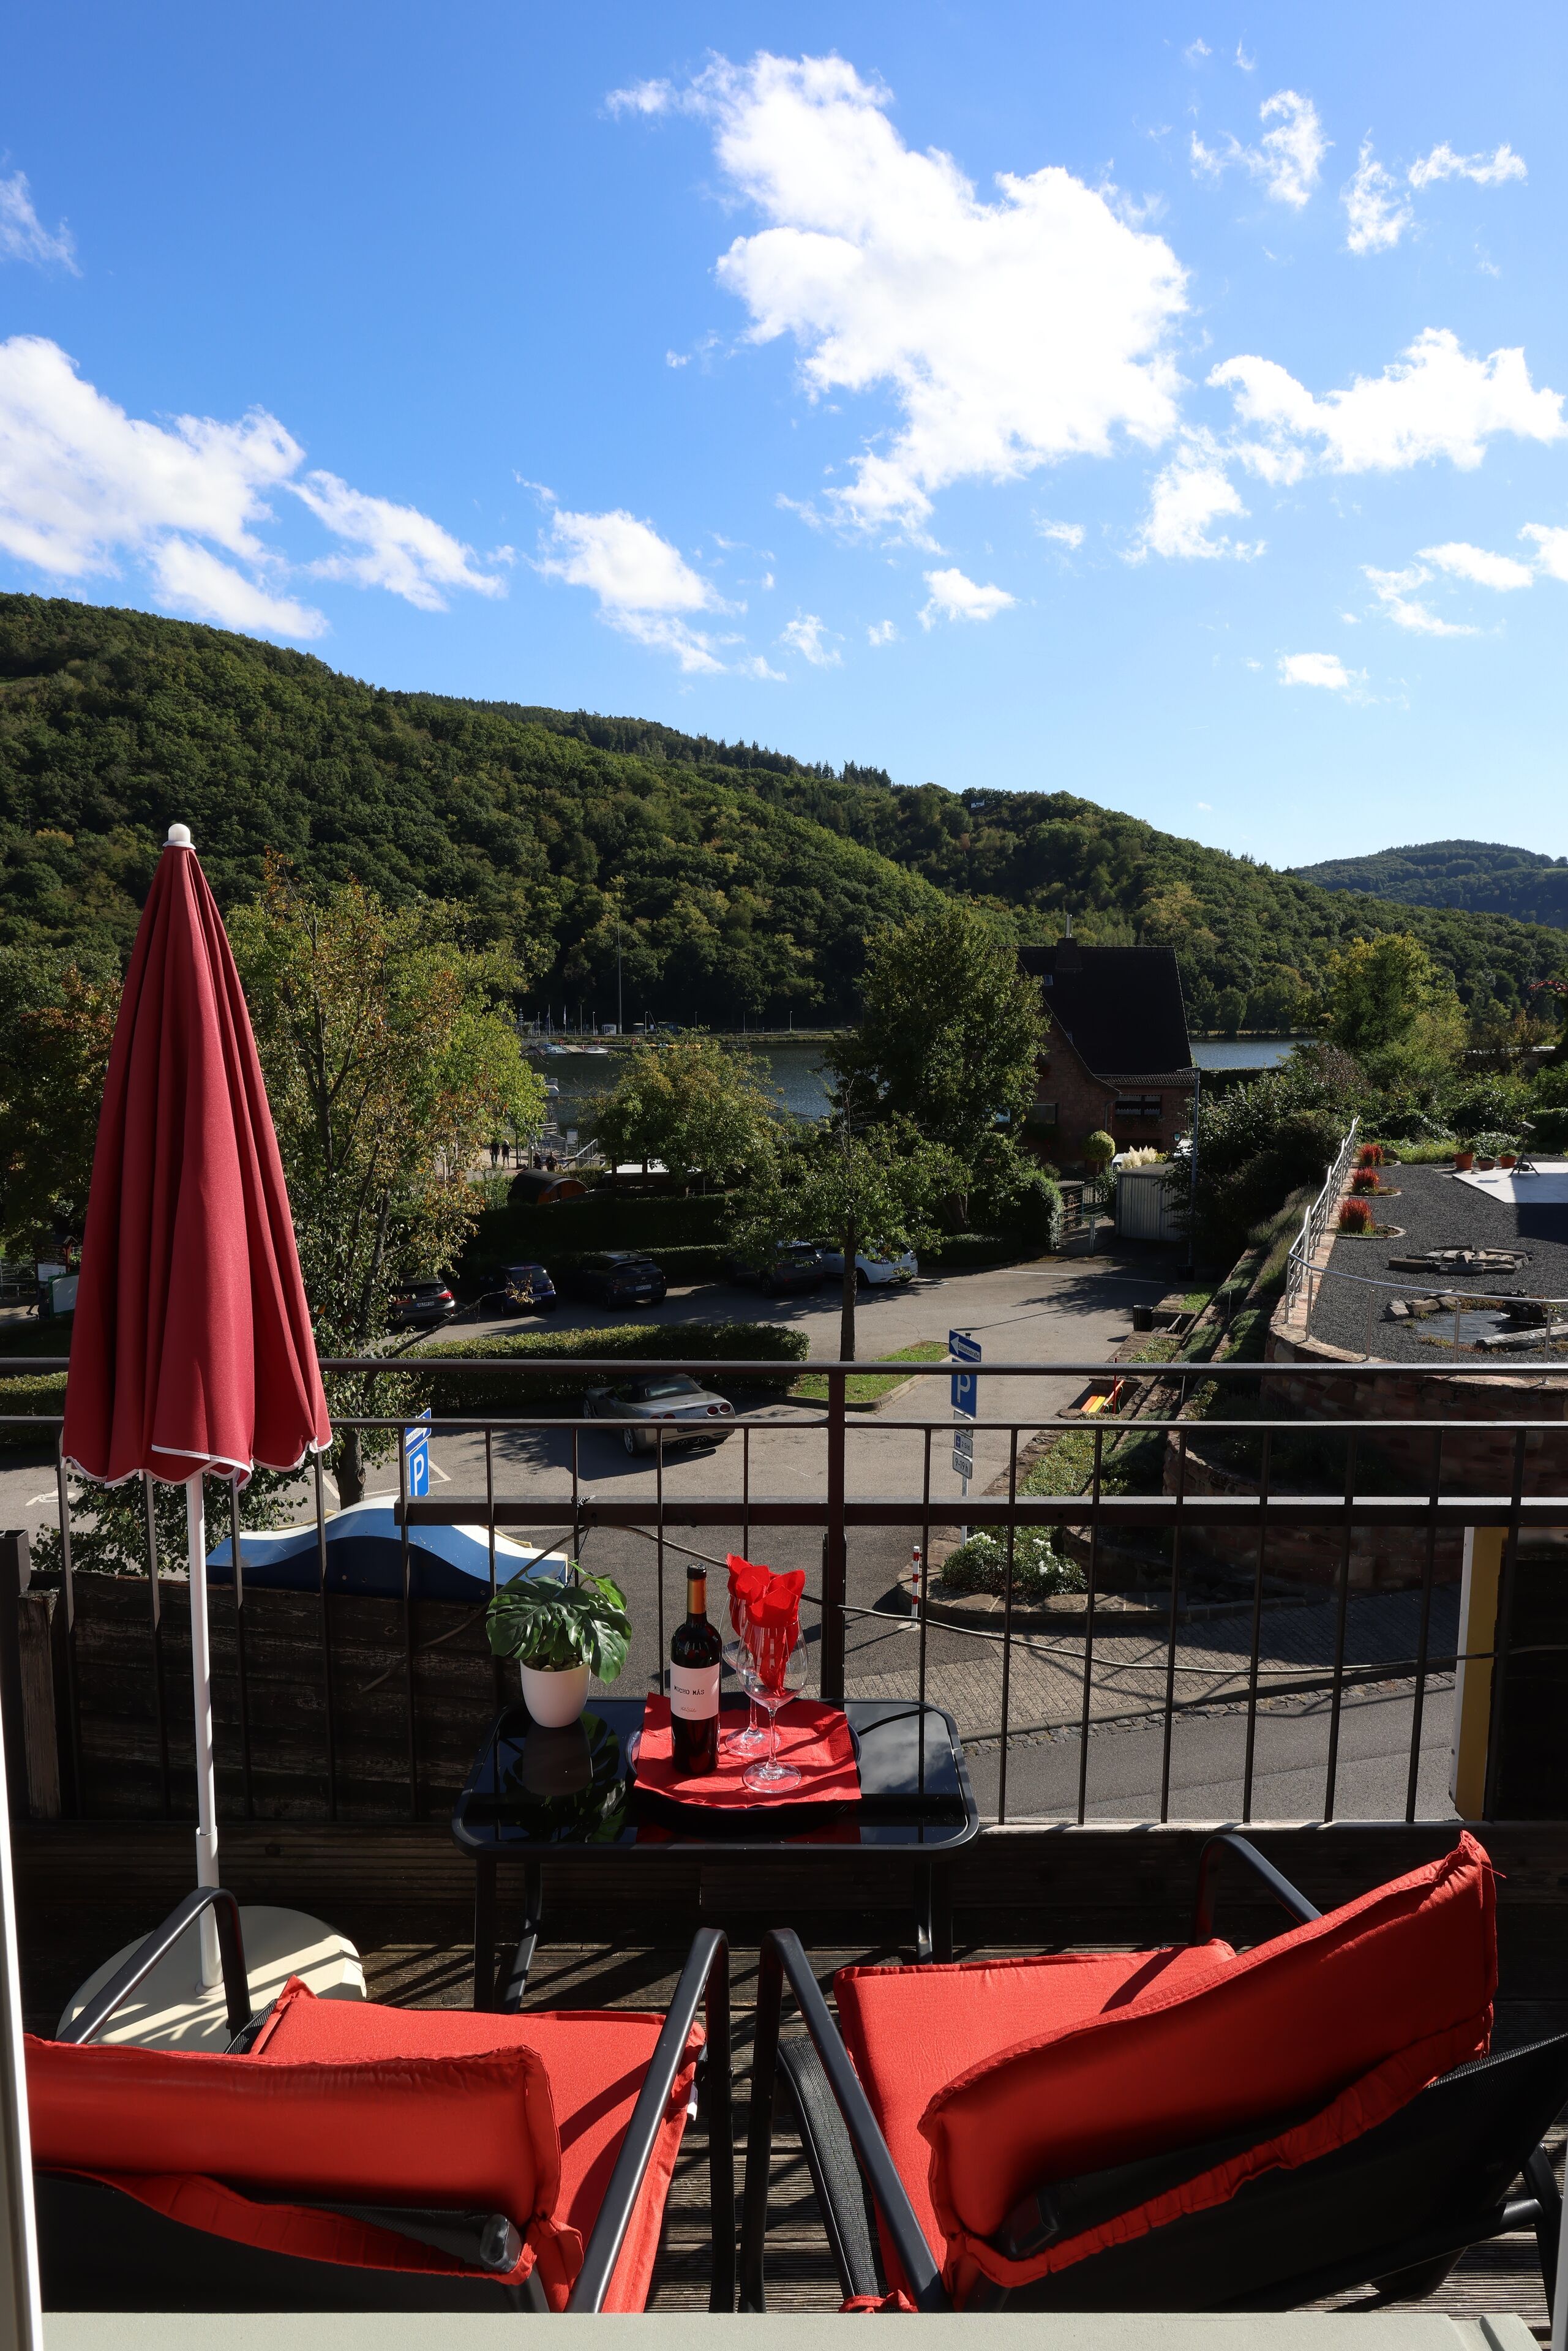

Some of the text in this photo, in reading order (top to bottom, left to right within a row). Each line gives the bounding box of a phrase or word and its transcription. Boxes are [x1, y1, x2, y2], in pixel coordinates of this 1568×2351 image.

[958, 1343, 980, 1359] Einbahnstraße
[958, 1374, 971, 1403] P
[413, 1453, 425, 1496] P
[674, 1685, 690, 1695] MUCHO
